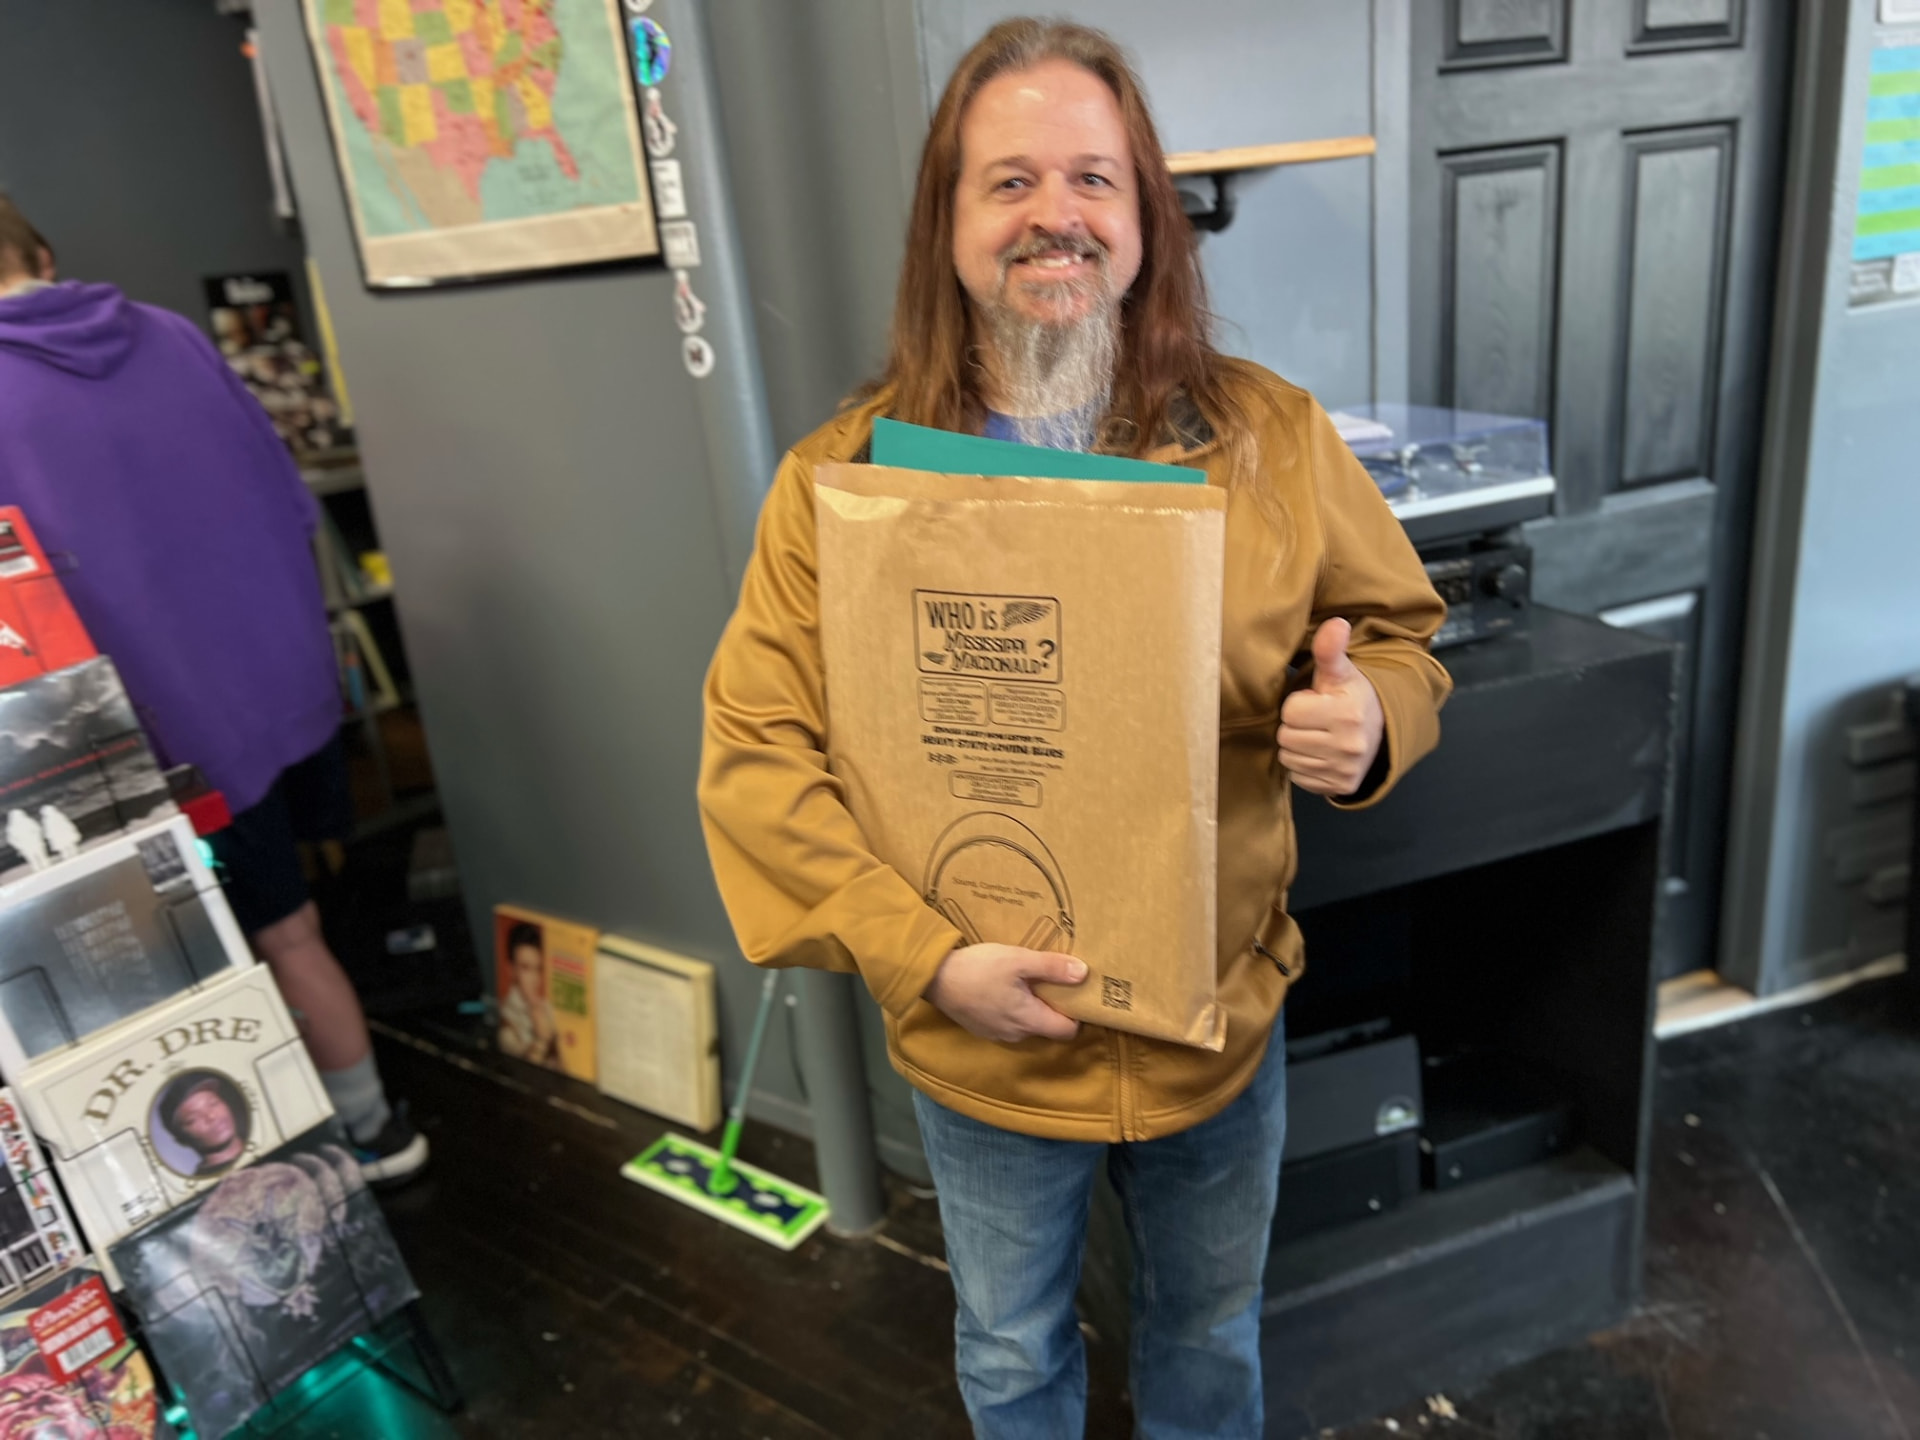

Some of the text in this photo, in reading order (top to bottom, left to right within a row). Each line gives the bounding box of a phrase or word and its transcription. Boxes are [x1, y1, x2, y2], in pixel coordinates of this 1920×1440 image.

[924, 600, 998, 631] WHO is
[81, 1016, 262, 1126] DR. DRE
